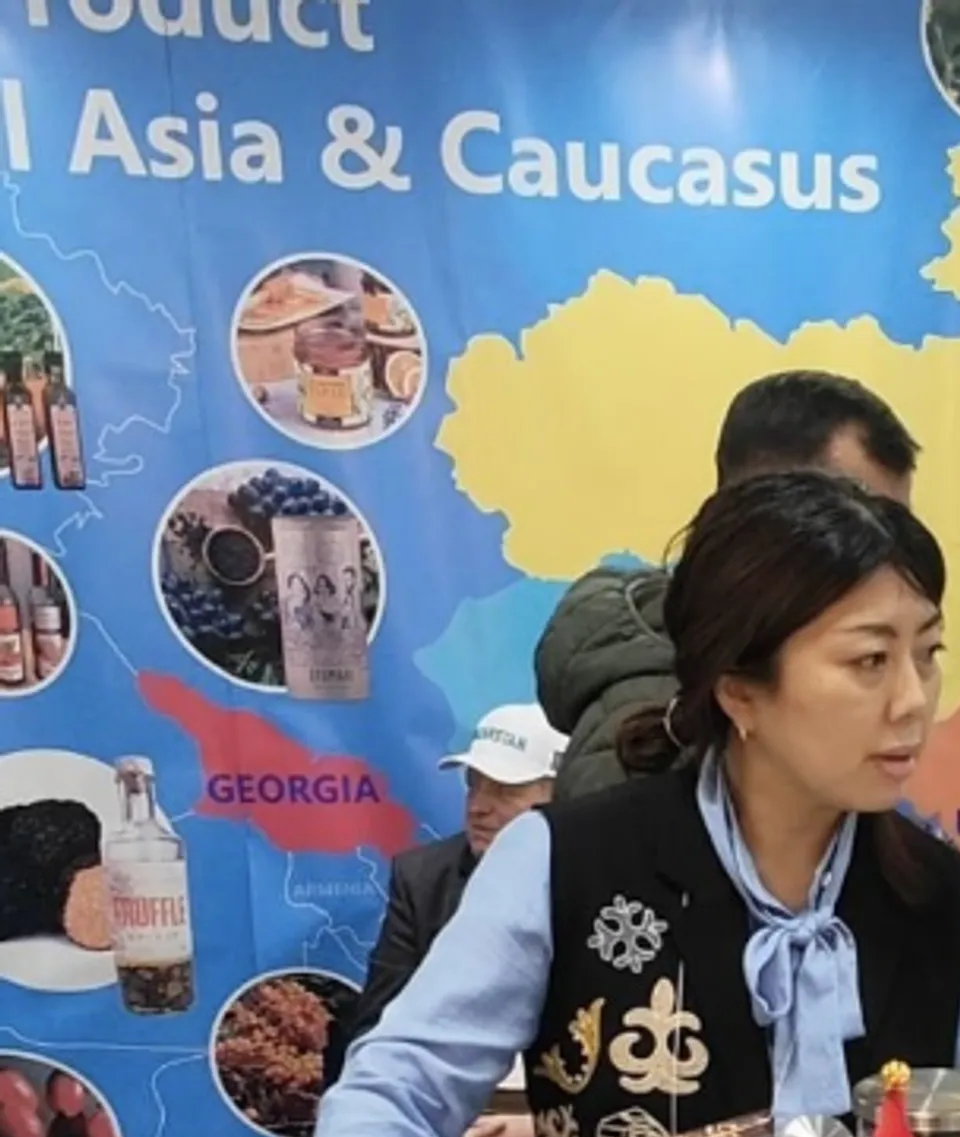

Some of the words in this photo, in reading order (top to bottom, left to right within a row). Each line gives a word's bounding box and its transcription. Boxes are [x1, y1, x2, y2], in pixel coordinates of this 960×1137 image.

[68, 88, 284, 184] Asia
[321, 104, 411, 191] &
[440, 110, 882, 213] Caucasus
[207, 773, 381, 805] GEORGIA
